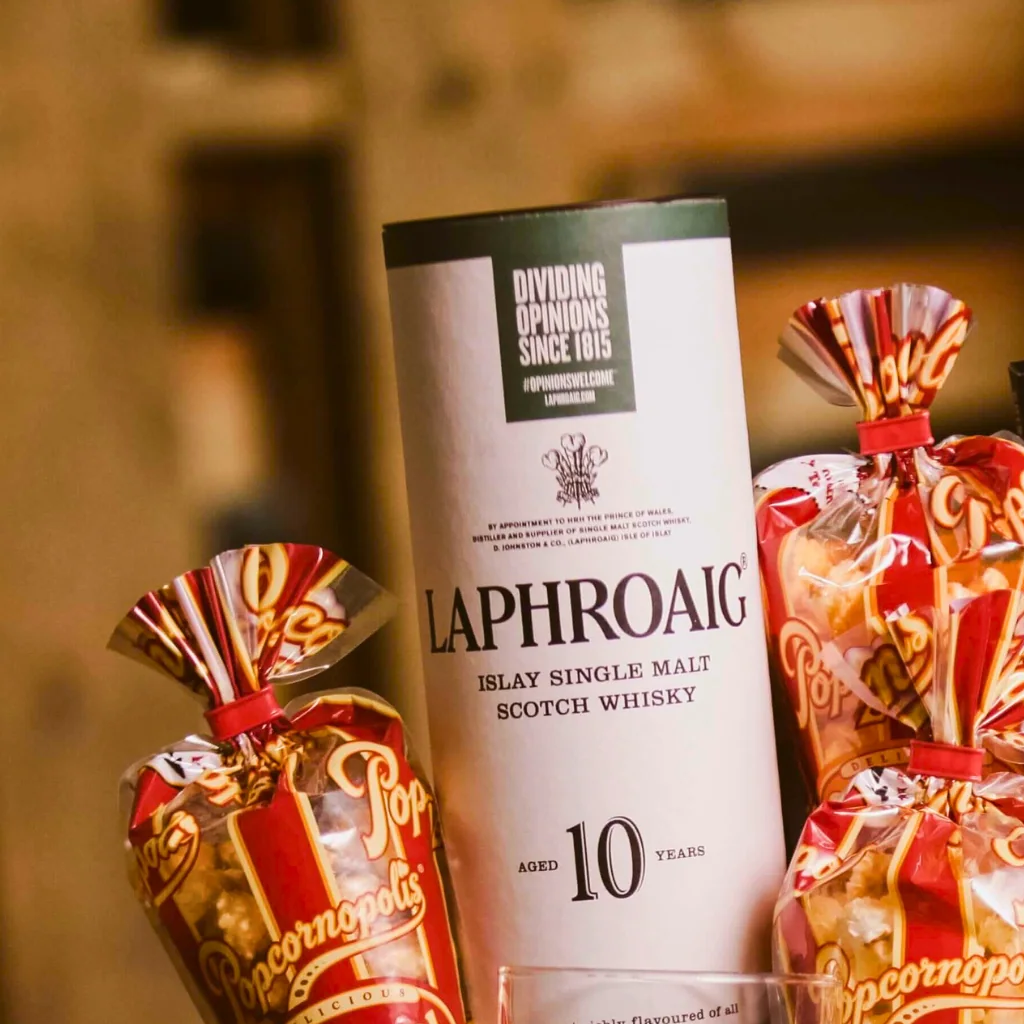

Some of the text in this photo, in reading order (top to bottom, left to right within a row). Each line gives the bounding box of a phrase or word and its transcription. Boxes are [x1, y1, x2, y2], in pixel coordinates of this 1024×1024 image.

[513, 261, 606, 304] DIVIDING
[516, 297, 610, 336] OPINIONS
[518, 329, 612, 366] SINCE 1815
[472, 533, 506, 543] DISTILLER
[508, 532, 523, 540] AND
[525, 528, 564, 538] SUPPLIER
[566, 526, 577, 534] OF
[579, 524, 608, 534] SINGLE
[610, 523, 629, 531] MALT
[632, 520, 661, 529] SCOTCH
[488, 523, 497, 531] BY
[500, 518, 553, 529] APPOINTMENT
[587, 514, 601, 522] THE
[604, 512, 633, 521] PRINCE
[635, 510, 645, 518] OF
[502, 541, 541, 551] JOHNSTON
[621, 533, 638, 541] ISLE
[640, 531, 650, 539] OF
[652, 529, 672, 538] ISLAY
[478, 655, 711, 692] ISLAY SINGLE MALT
[497, 686, 697, 720] SCOTCH WHISKY
[518, 816, 705, 902] AGED 10 YEARS
[709, 1006, 722, 1020] of
[724, 1003, 740, 1016] all
